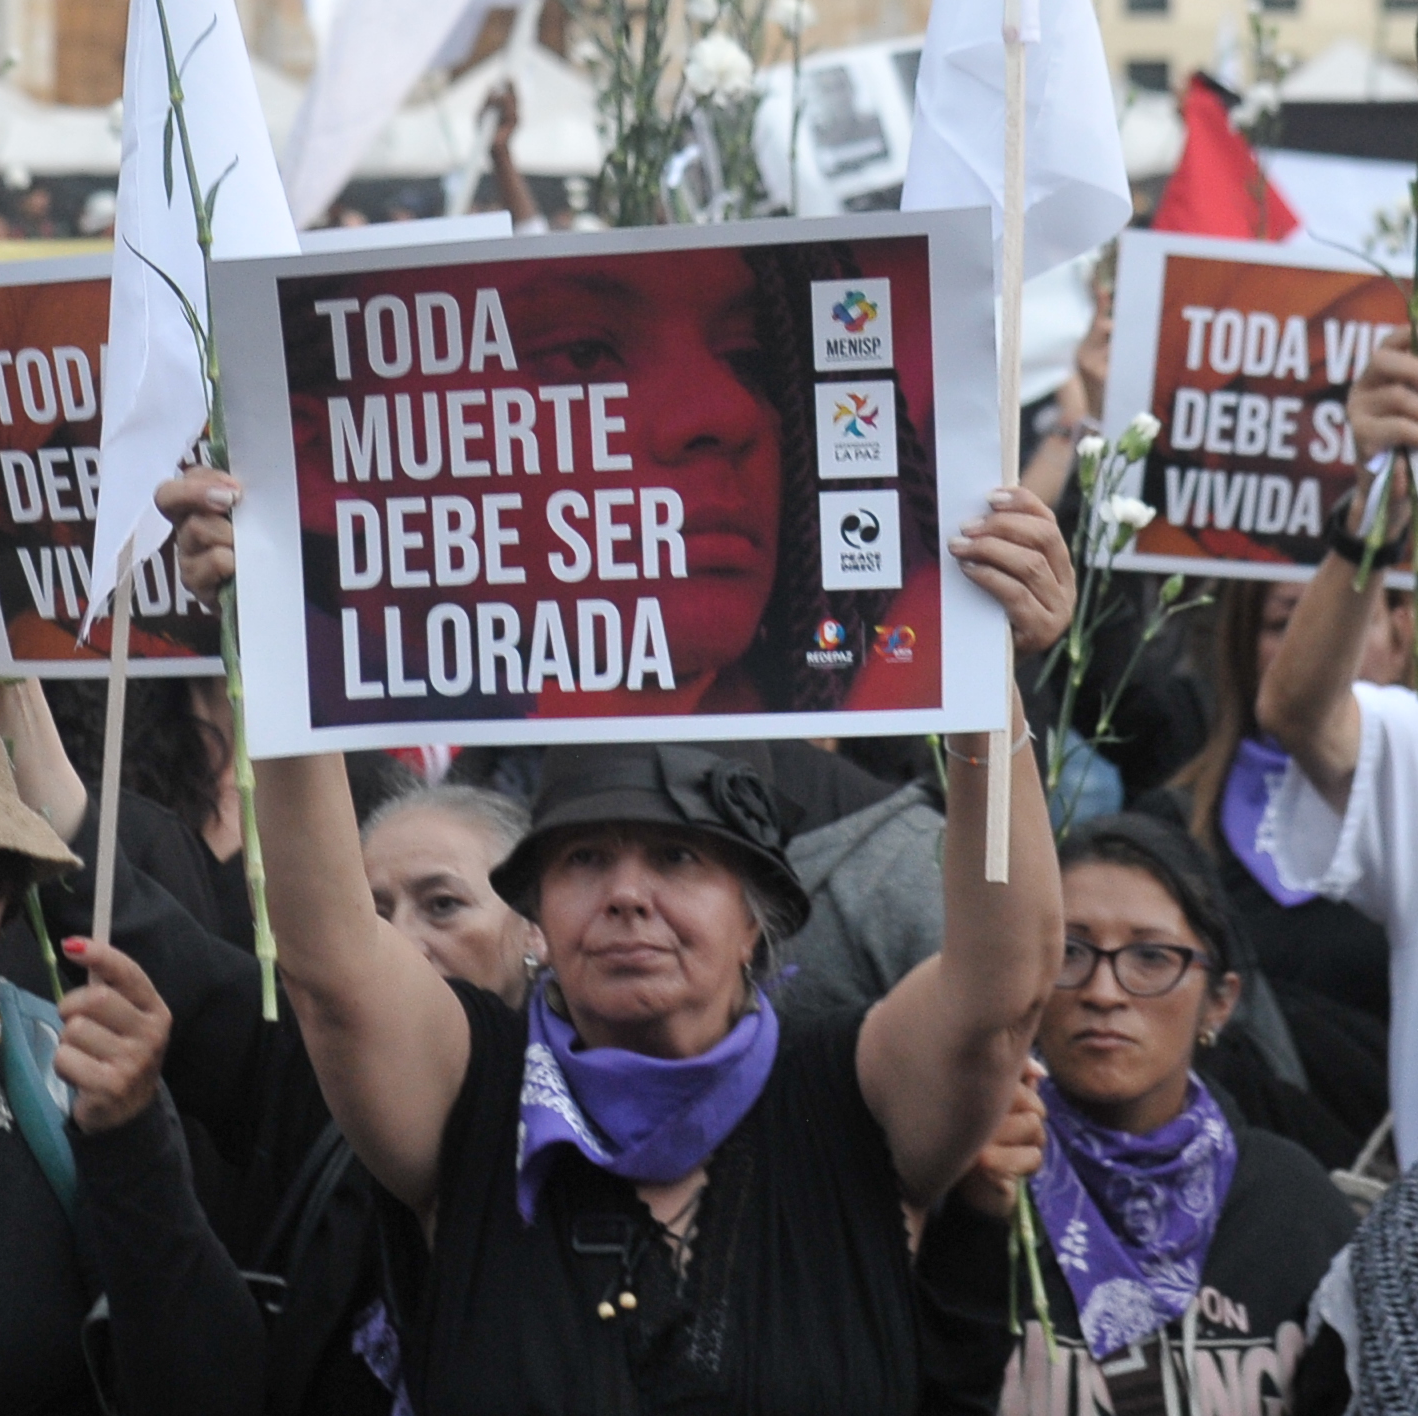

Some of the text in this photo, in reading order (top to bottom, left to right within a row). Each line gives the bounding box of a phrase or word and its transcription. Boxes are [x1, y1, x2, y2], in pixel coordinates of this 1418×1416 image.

[314, 287, 519, 381] TODA
[826, 337, 881, 356] MENISP
[1182, 305, 1310, 382] TODA
[327, 381, 634, 483] MUERTE
[1170, 388, 1304, 461] DEBE
[0, 446, 101, 524] DEB
[1164, 465, 1323, 539] VIVIDA
[335, 487, 689, 591] DEBE SER
[341, 596, 677, 701] LLORADA
